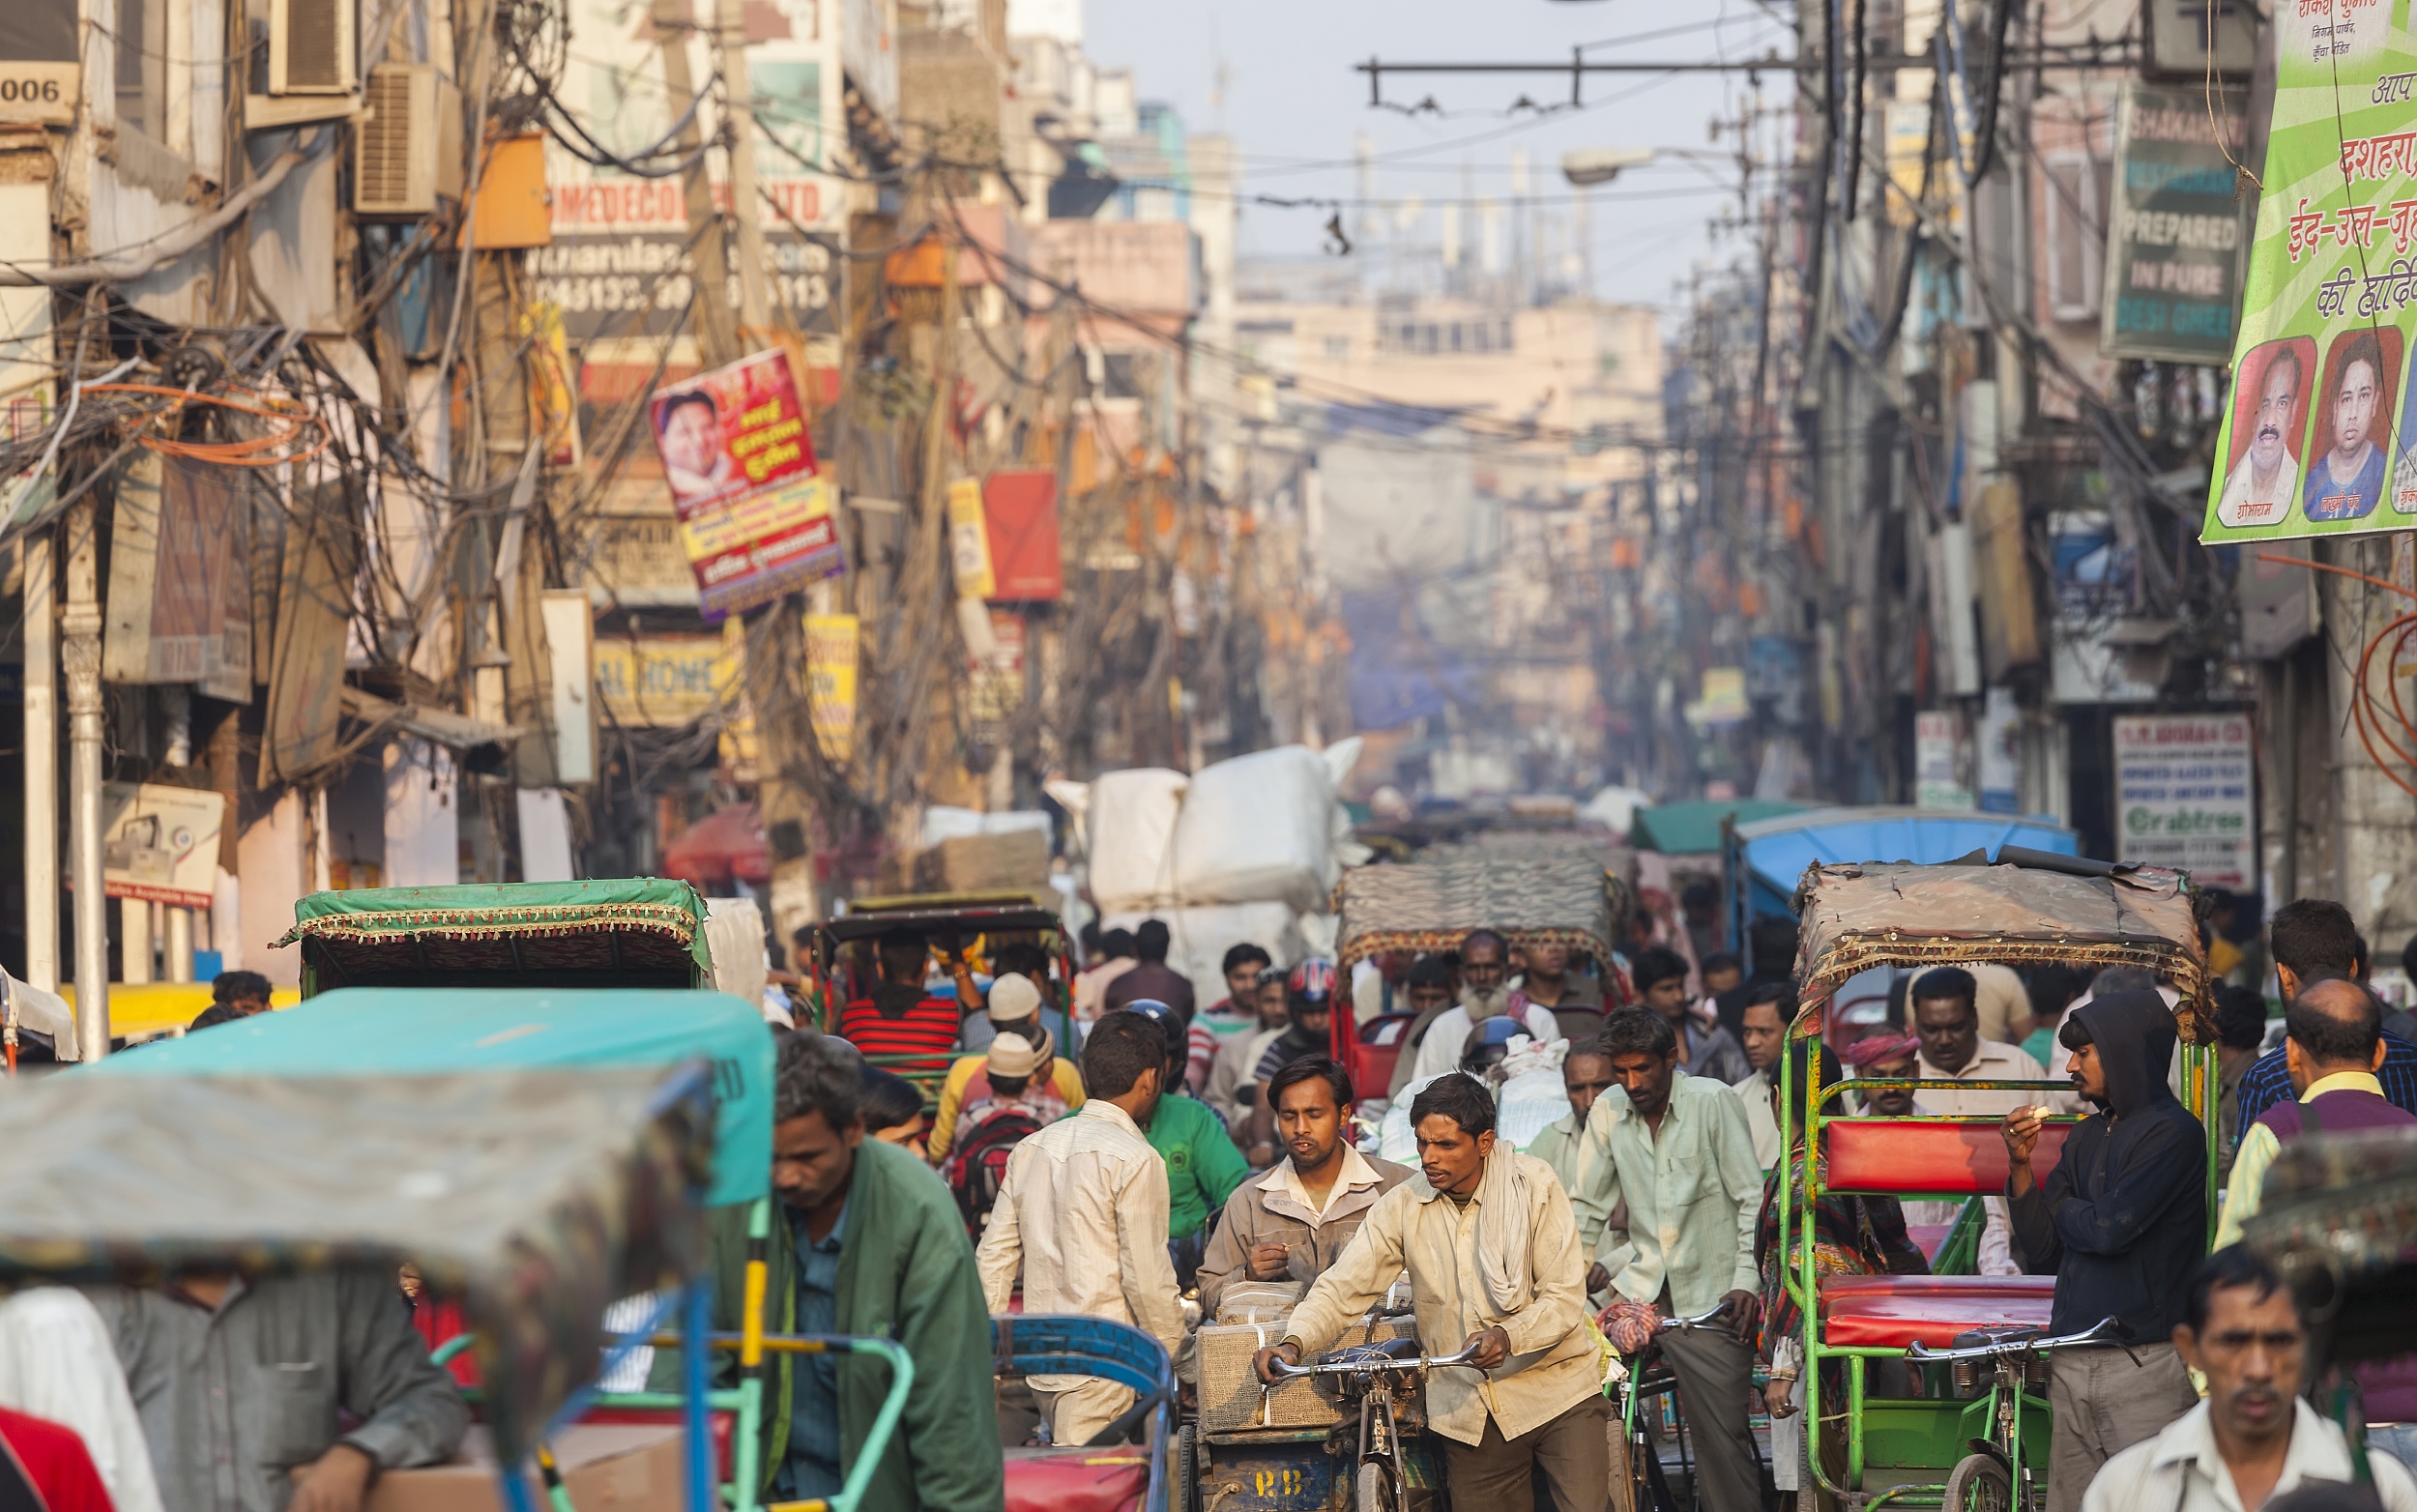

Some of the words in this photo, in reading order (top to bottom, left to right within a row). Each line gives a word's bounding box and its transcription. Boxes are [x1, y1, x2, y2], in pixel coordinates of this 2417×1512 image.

[2372, 72, 2417, 104] आप
[2123, 208, 2237, 250] PREPARED
[2131, 260, 2157, 290] IN
[2161, 261, 2223, 296] PURE
[2317, 268, 2355, 317] की
[2116, 298, 2167, 332] DESI
[2172, 302, 2231, 336] GHEE
[2127, 806, 2244, 836] Crabtree
